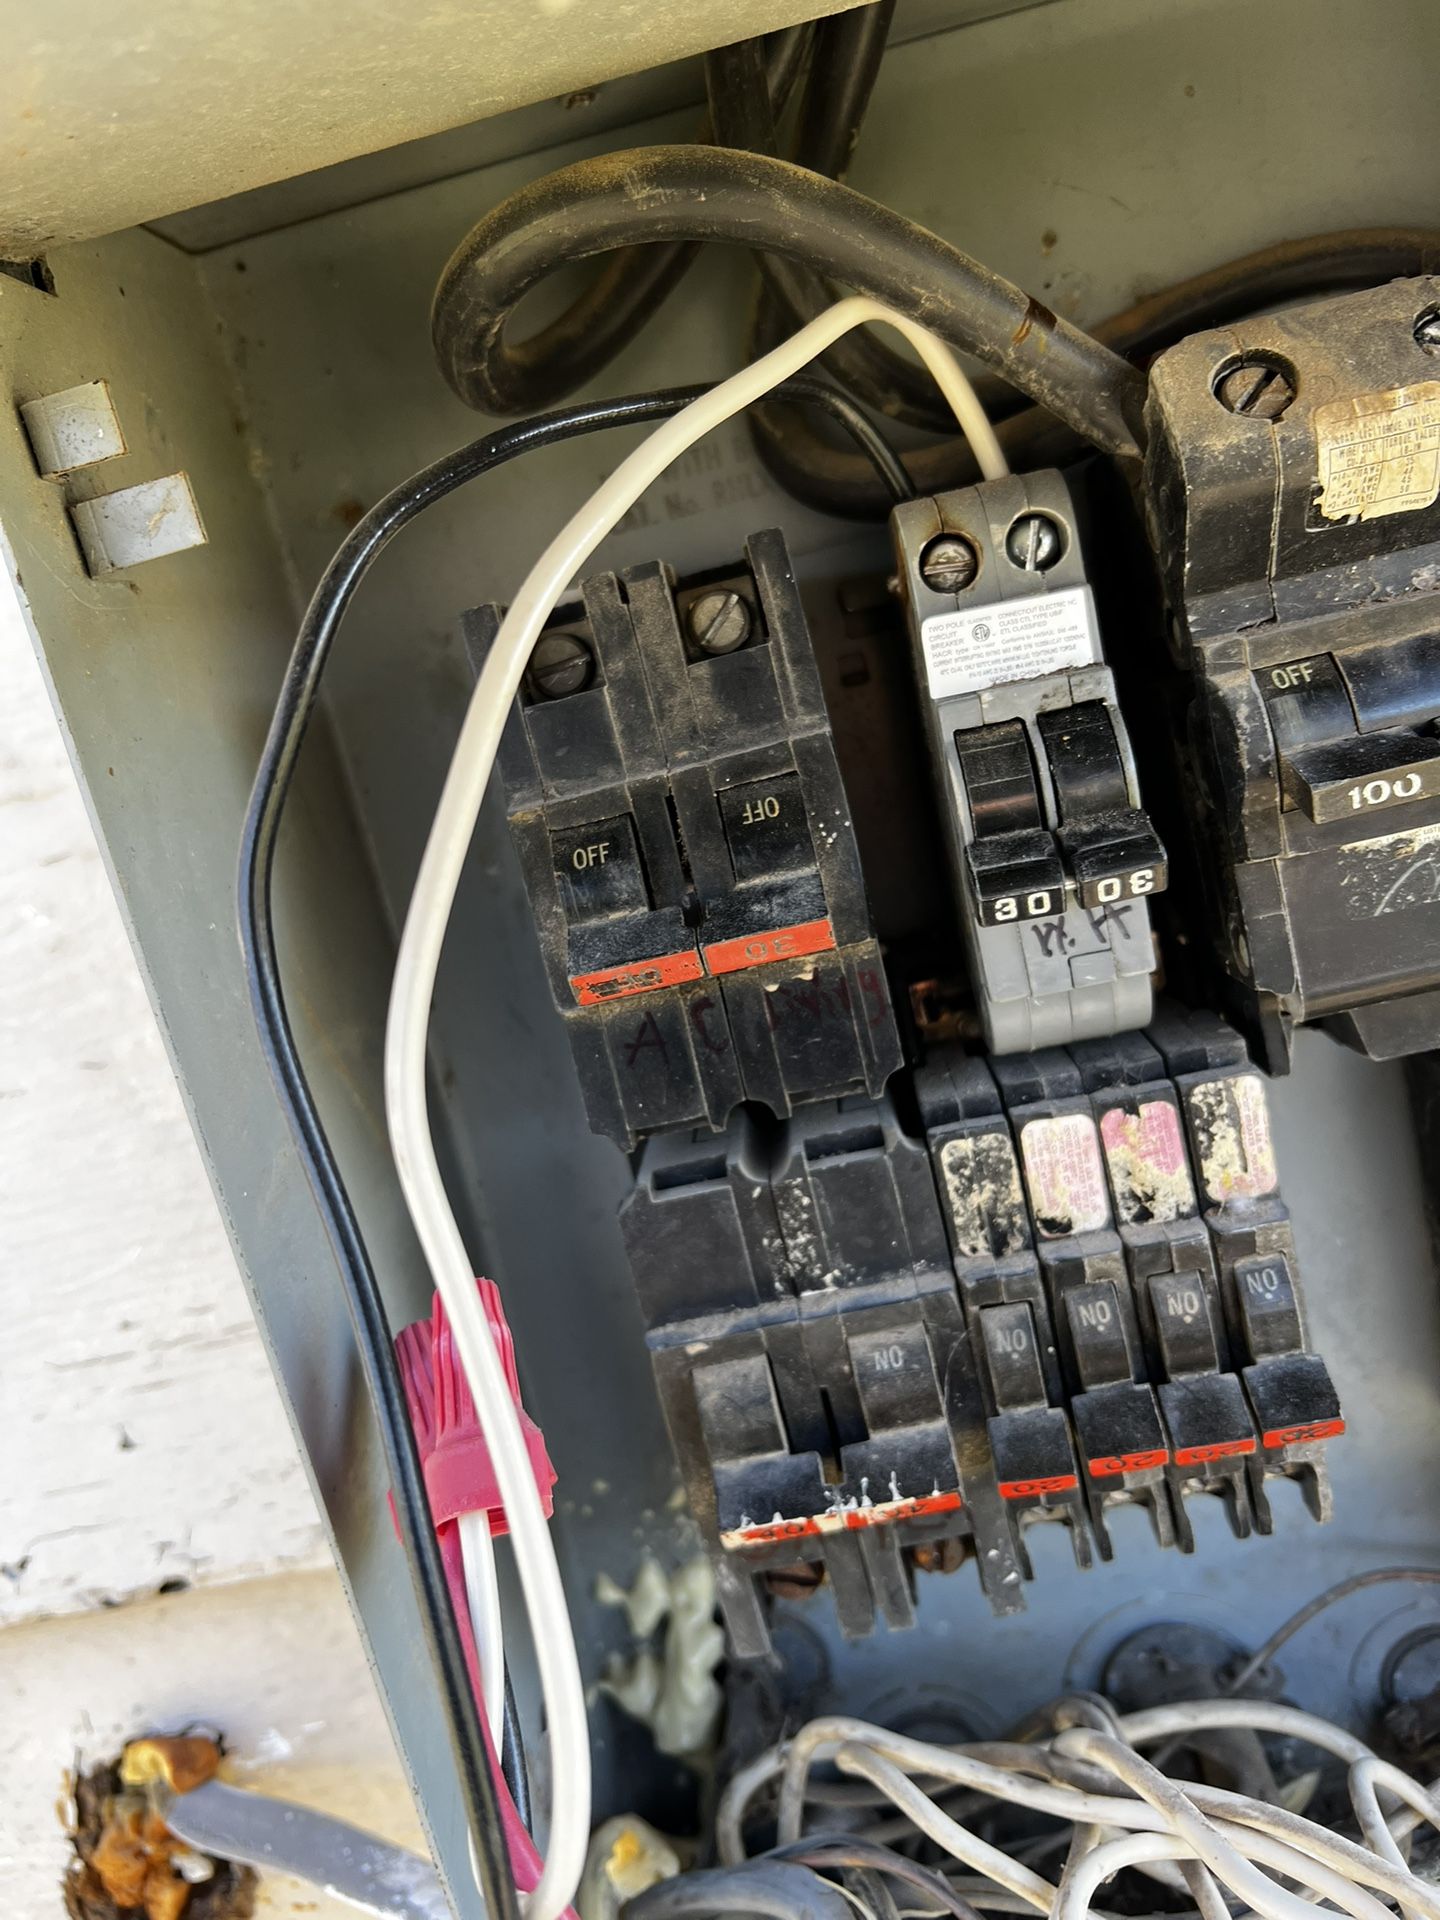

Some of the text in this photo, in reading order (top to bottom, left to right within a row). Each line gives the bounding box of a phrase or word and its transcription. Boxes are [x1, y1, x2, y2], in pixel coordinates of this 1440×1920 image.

[1038, 601, 1066, 611] ELECTRIC
[927, 624, 944, 632] TWO
[998, 618, 1018, 626] CLASS
[928, 631, 958, 641] CIRCUIT
[929, 638, 964, 650] BREAKER
[1271, 661, 1314, 690] OFF
[1348, 772, 1422, 810] 100
[741, 796, 781, 826] OFF
[572, 842, 611, 871] OFF
[1097, 868, 1155, 904] 30
[994, 890, 1052, 922] 30
[744, 934, 797, 961] 30
[1246, 1267, 1280, 1294] ON
[1077, 1299, 1111, 1328] ON
[1166, 1290, 1199, 1318] ON
[995, 1326, 1028, 1353] ON
[873, 1343, 905, 1371] ON
[1105, 1453, 1155, 1471] 20
